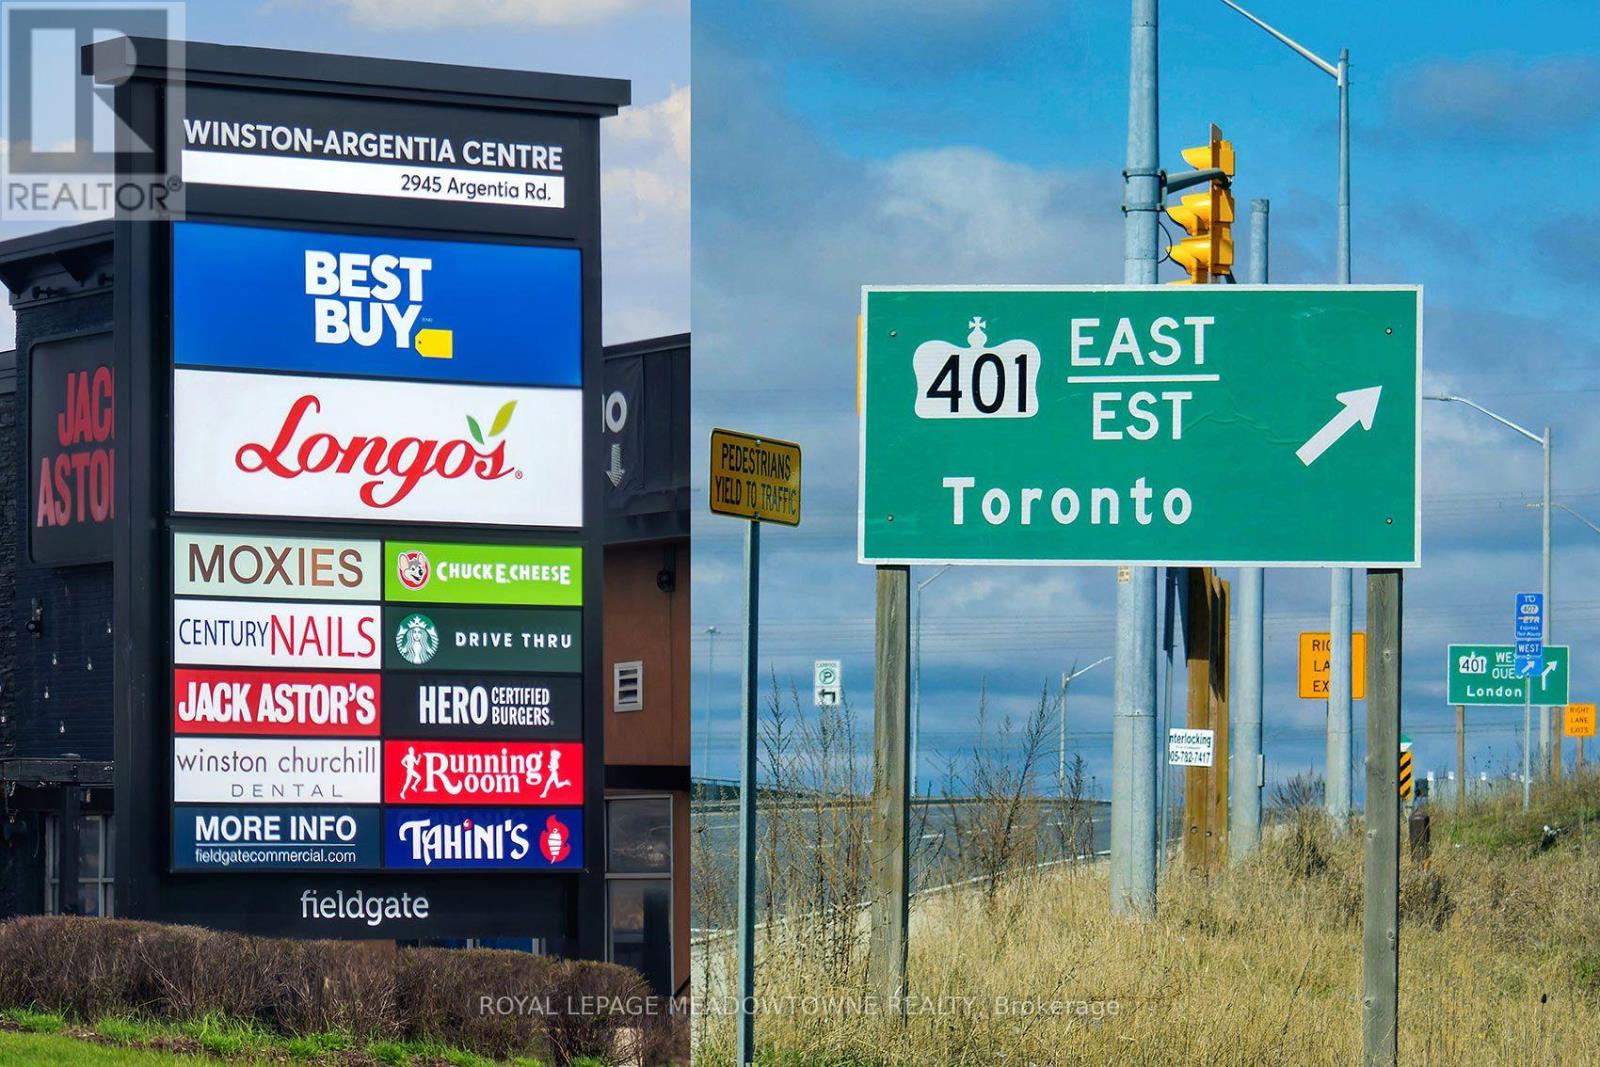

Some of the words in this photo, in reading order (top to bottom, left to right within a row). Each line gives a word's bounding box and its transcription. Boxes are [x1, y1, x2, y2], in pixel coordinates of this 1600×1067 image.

[183, 119, 456, 163] WINSTON-ARGENTIA
[462, 141, 563, 171] CENTRE
[400, 174, 442, 194] 2945
[447, 179, 519, 201] Argentia
[525, 182, 552, 201] Rd.
[304, 249, 432, 302] BEST
[314, 298, 422, 349] BUY
[926, 353, 1028, 414] 401
[1070, 316, 1215, 366] EAST
[57, 366, 115, 447] JAC
[1092, 391, 1193, 441] EST
[721, 442, 791, 481] PEDESTRIANS
[715, 475, 742, 505] YIELD
[746, 480, 757, 508] TO
[761, 483, 797, 515] TRAFFIC
[942, 476, 1193, 525] Toronto
[188, 543, 364, 588] MOXIES
[178, 618, 269, 647] CENTURY
[270, 614, 376, 659] NAILS
[455, 631, 513, 648] DRIVE
[521, 633, 572, 648] THRU
[1518, 644, 1539, 653] WEST
[1461, 659, 1484, 672] 401
[1495, 652, 1515, 663] WE
[178, 681, 252, 722] JACK
[257, 682, 376, 725] ASTOR'S
[419, 685, 489, 725] HERO
[491, 686, 550, 705] CERTIFIED
[1466, 685, 1522, 697] London
[177, 748, 267, 773] winston
[278, 746, 376, 773] churchill
[423, 748, 543, 795] Running
[231, 784, 343, 798] DENTAL
[195, 815, 281, 841] MORE
[290, 815, 357, 841] INFO
[195, 848, 356, 866] fieldgatecommercial.com
[300, 889, 429, 927] fieldgate
